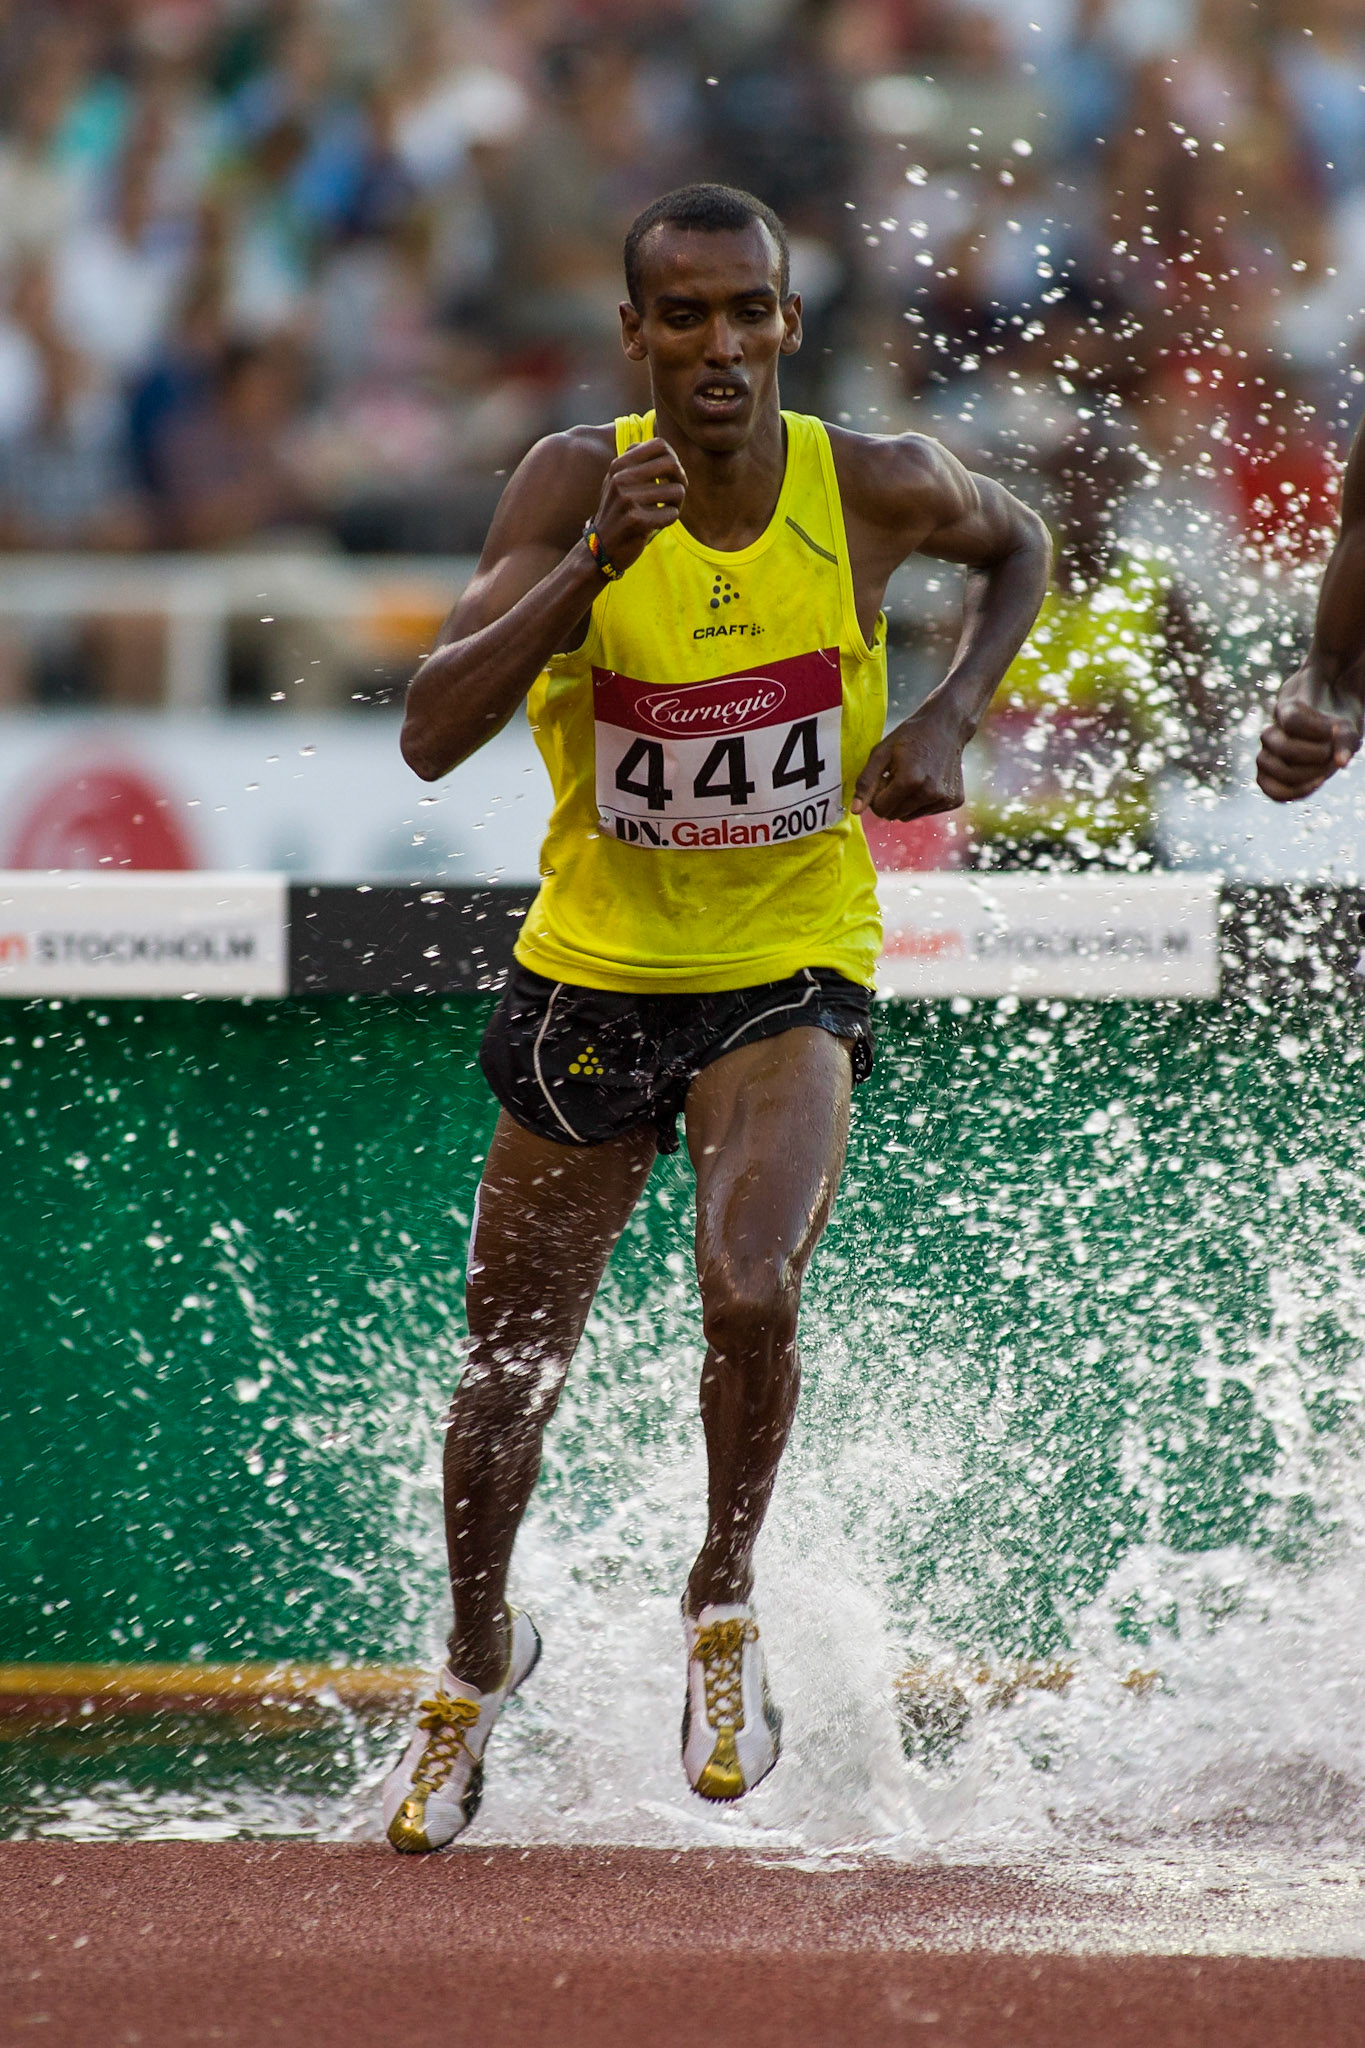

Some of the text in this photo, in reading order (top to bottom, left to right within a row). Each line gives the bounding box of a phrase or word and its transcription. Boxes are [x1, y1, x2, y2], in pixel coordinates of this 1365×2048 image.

[693, 624, 749, 640] CRAFT
[645, 688, 777, 725] Carnegie
[615, 716, 826, 812] 444
[38, 929, 256, 966] STOCKHOLM
